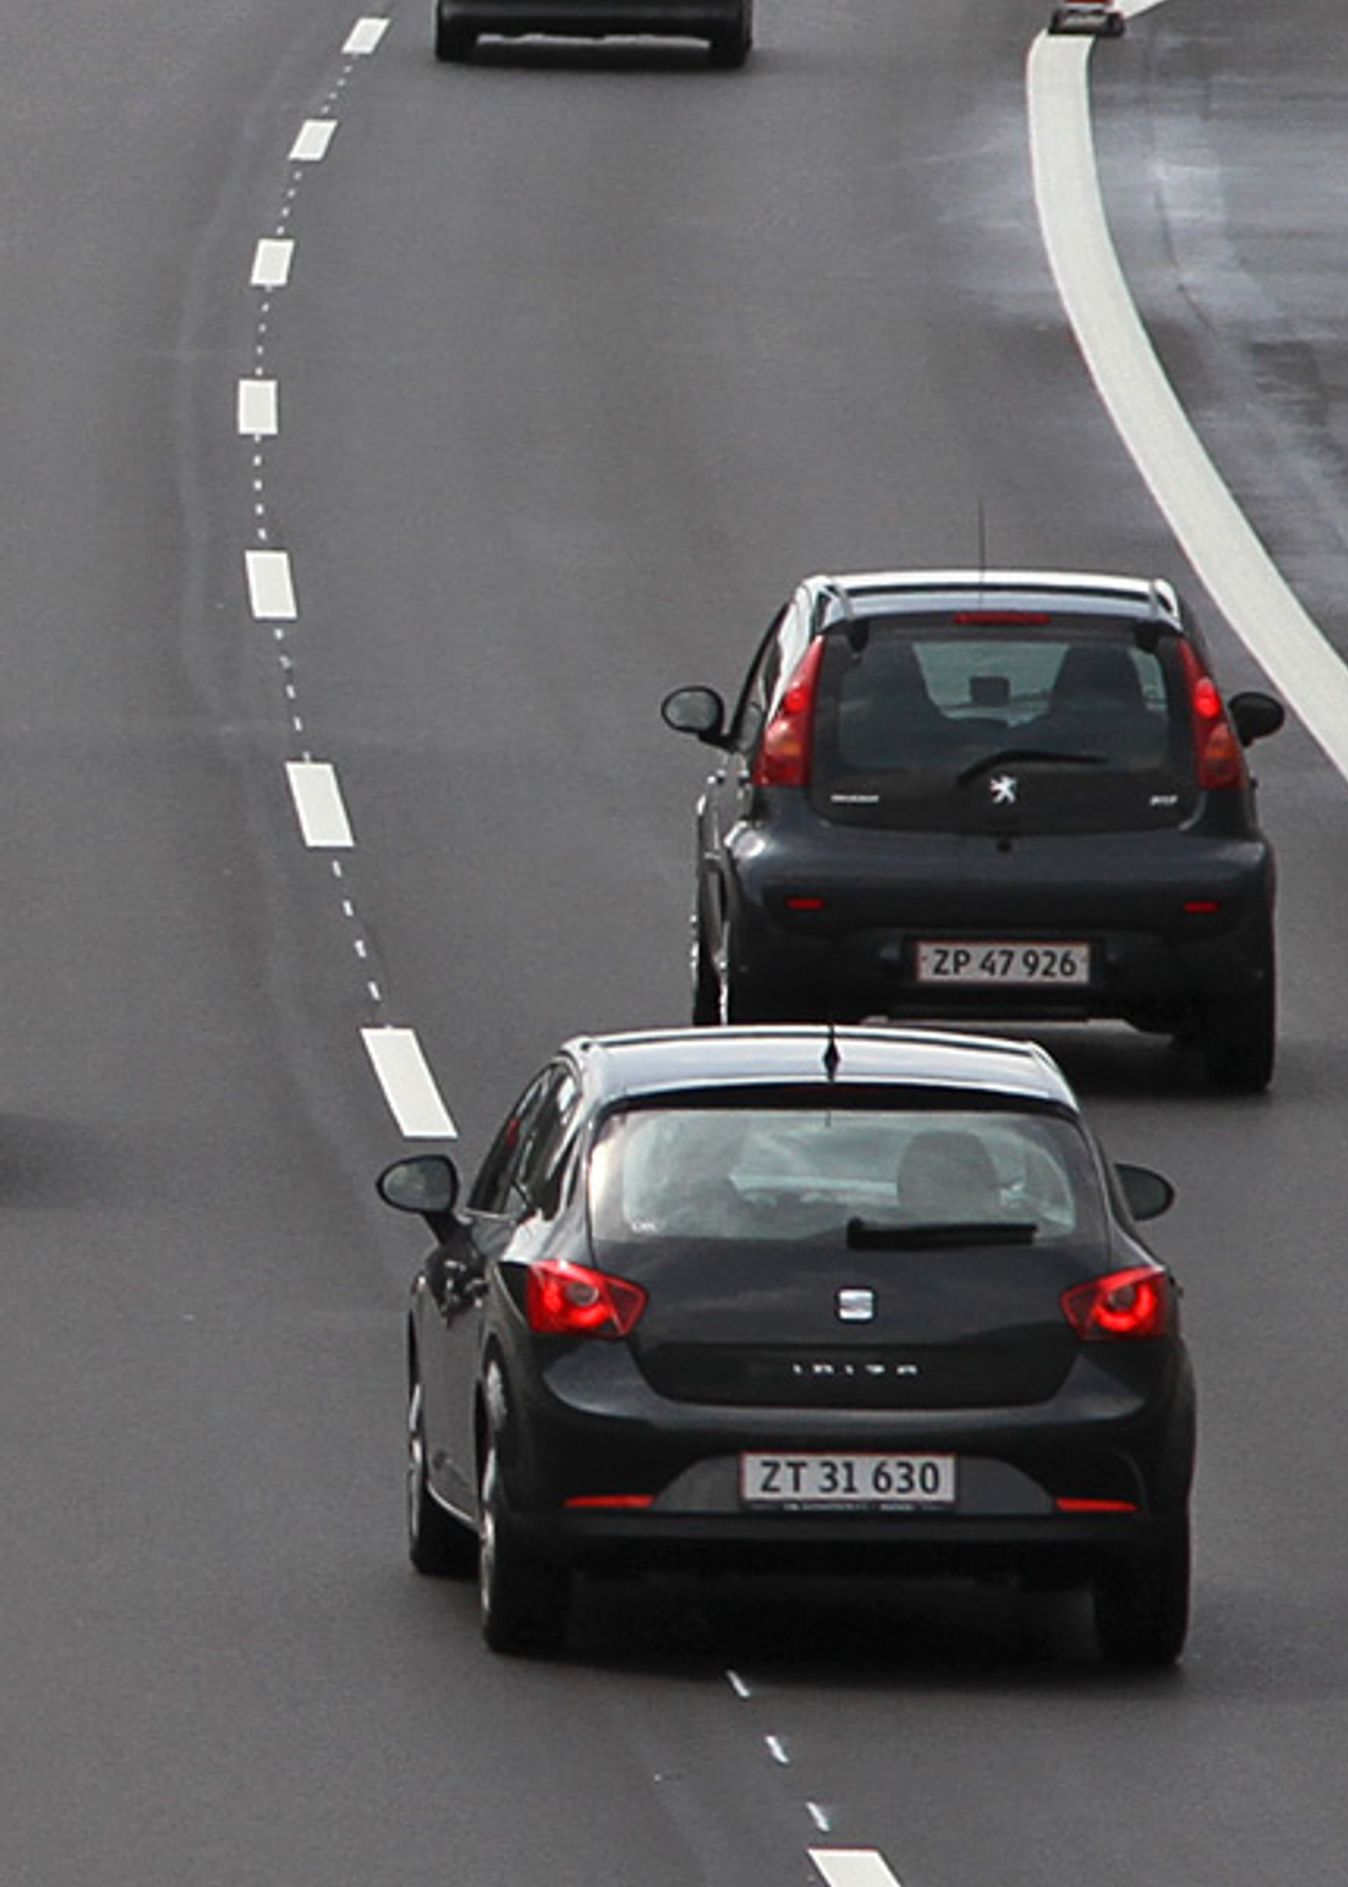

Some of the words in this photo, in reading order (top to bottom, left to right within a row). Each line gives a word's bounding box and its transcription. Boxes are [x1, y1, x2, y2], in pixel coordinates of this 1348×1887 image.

[933, 949, 970, 975] ZP
[980, 949, 1014, 976] 47
[1022, 949, 1077, 977] 926
[760, 1462, 807, 1493] ZT
[819, 1462, 858, 1493] 31
[873, 1462, 940, 1494] 630
